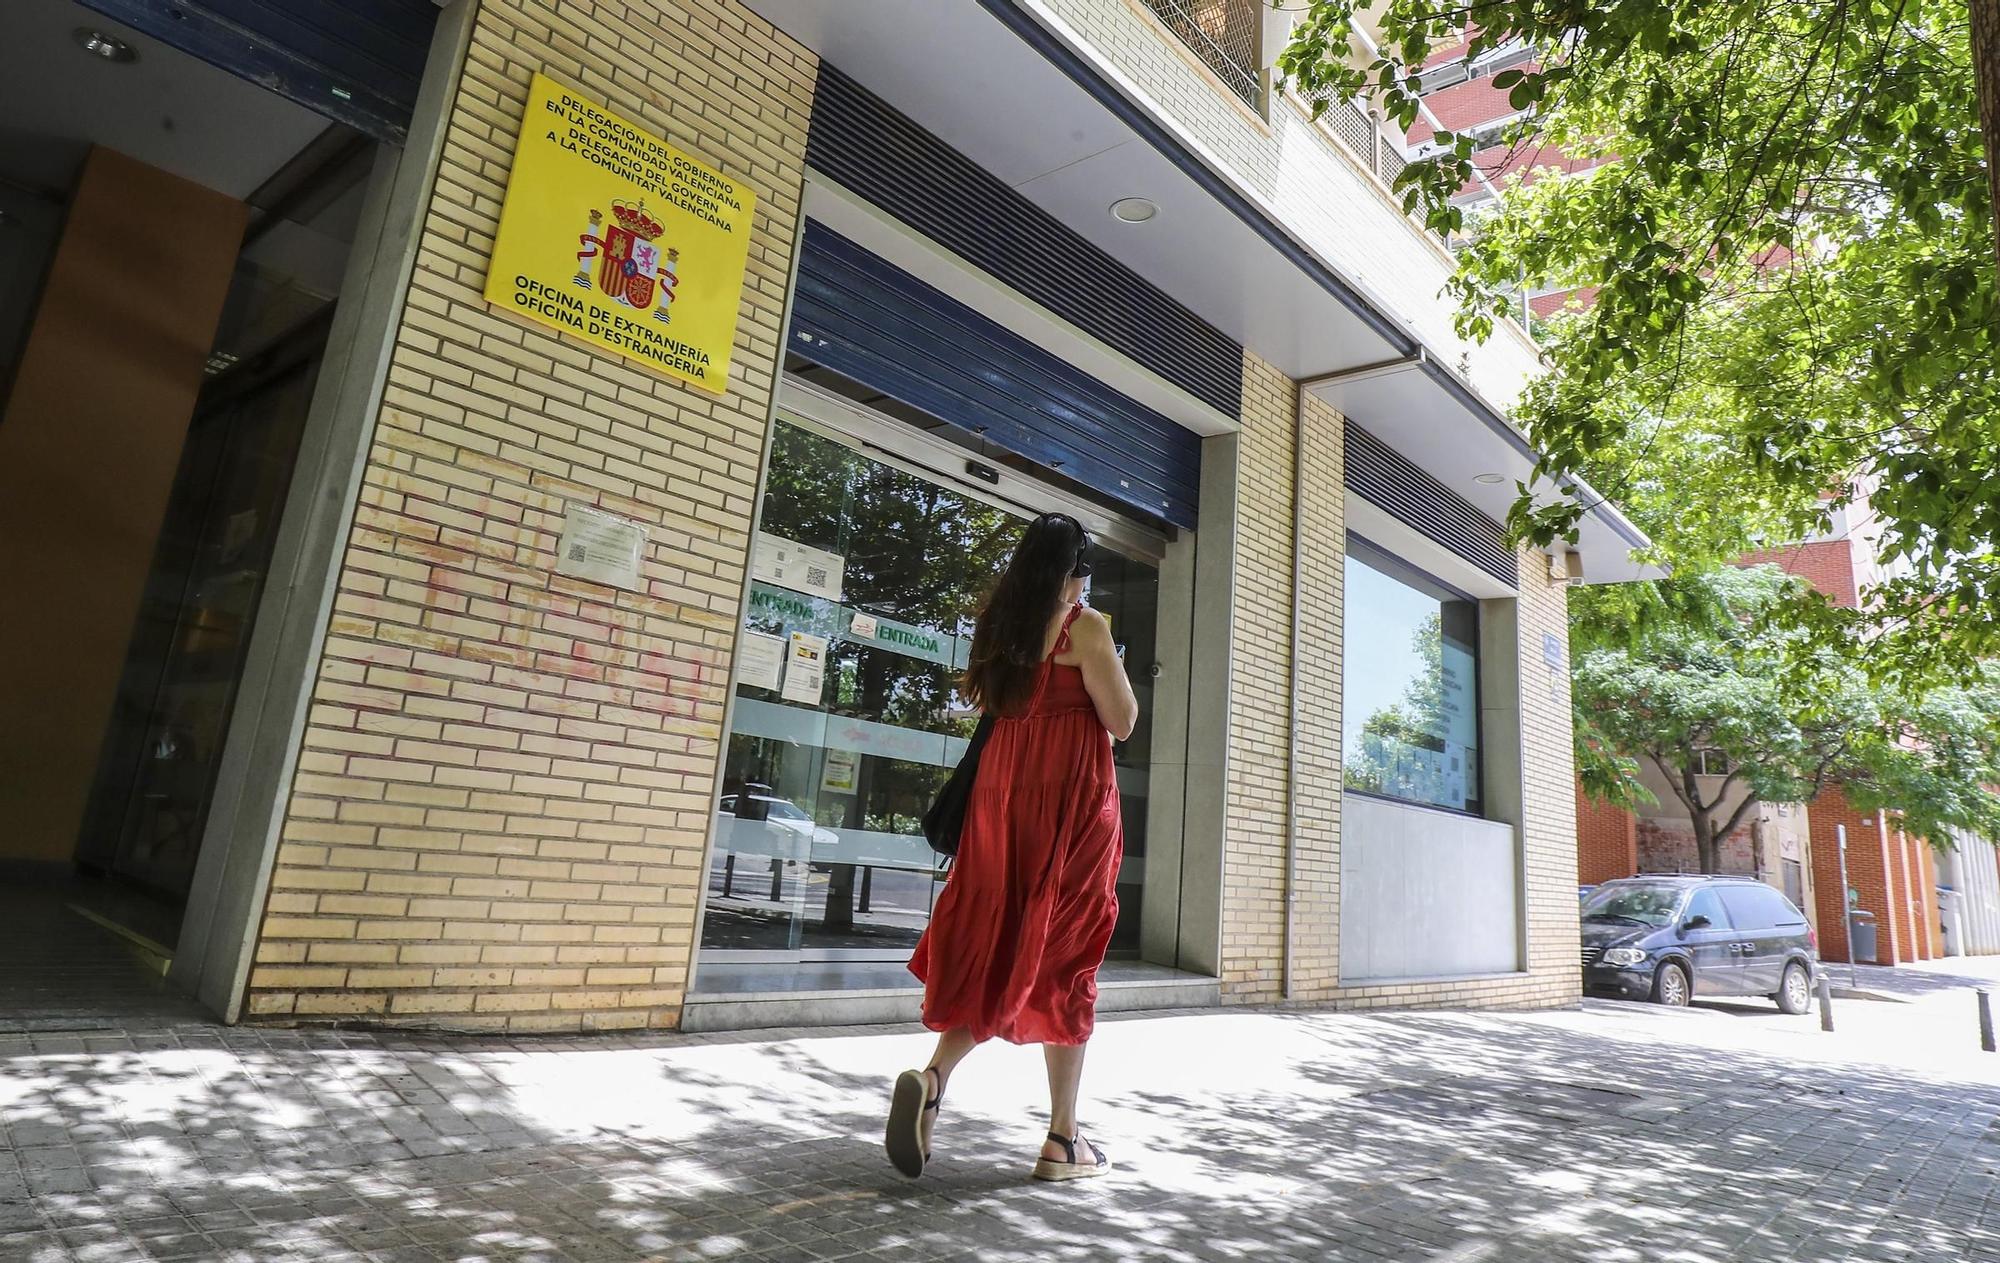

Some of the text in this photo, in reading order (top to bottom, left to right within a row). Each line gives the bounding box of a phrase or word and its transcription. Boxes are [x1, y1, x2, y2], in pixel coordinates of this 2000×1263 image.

[546, 100, 740, 211] EN LA COMUNIDAD VALENCIANA
[546, 131, 731, 233] A LA COMUNITAT VALENCIANA
[561, 95, 733, 194] DELEGACIÓN DEL GOBIERNO
[569, 128, 719, 213] DELEGACIÓ DEL GOVERN
[515, 292, 583, 330] OFICINA
[515, 276, 709, 366] OFICINA DE EXTRANJERÍA
[750, 589, 815, 620] NTRADA
[880, 625, 938, 653] ENTRADA
